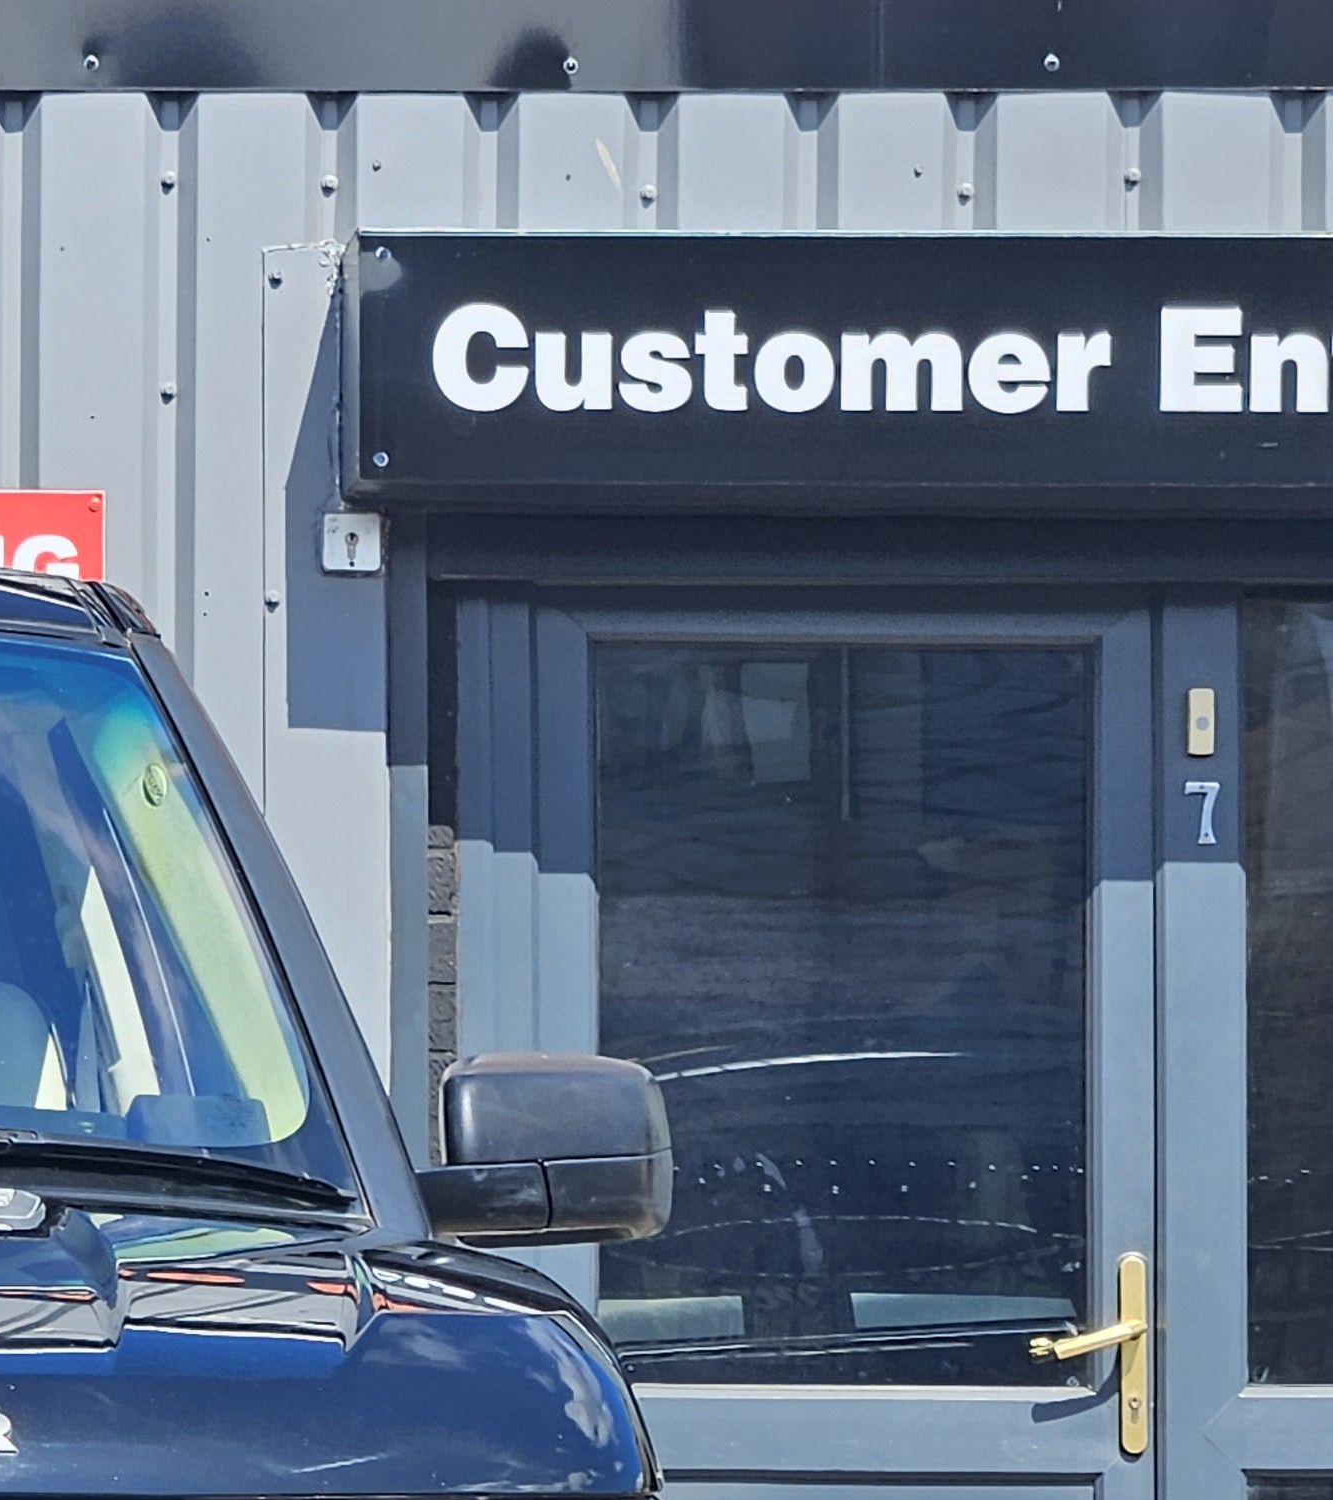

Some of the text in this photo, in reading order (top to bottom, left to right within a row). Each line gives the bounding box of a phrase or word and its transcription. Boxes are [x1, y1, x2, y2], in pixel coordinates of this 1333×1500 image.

[432, 302, 1333, 414] Customer En
[1183, 780, 1221, 846] 7
